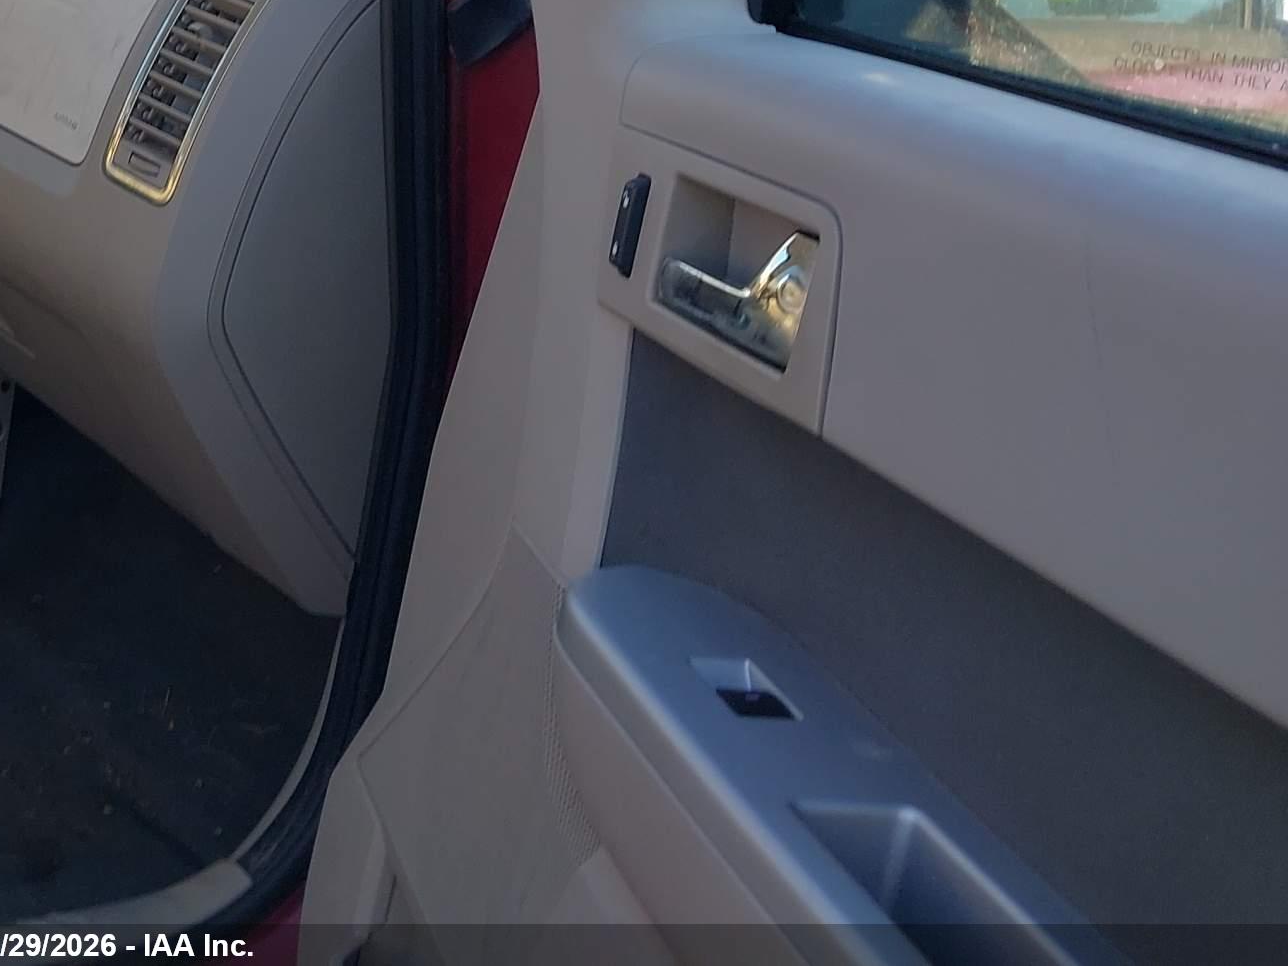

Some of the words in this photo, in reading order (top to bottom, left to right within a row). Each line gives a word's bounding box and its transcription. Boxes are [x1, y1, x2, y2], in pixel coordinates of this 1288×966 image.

[1130, 40, 1200, 61] OBJECTS
[1210, 50, 1226, 65] IN
[1184, 66, 1224, 84] THAN
[1234, 73, 1272, 90] THEY
